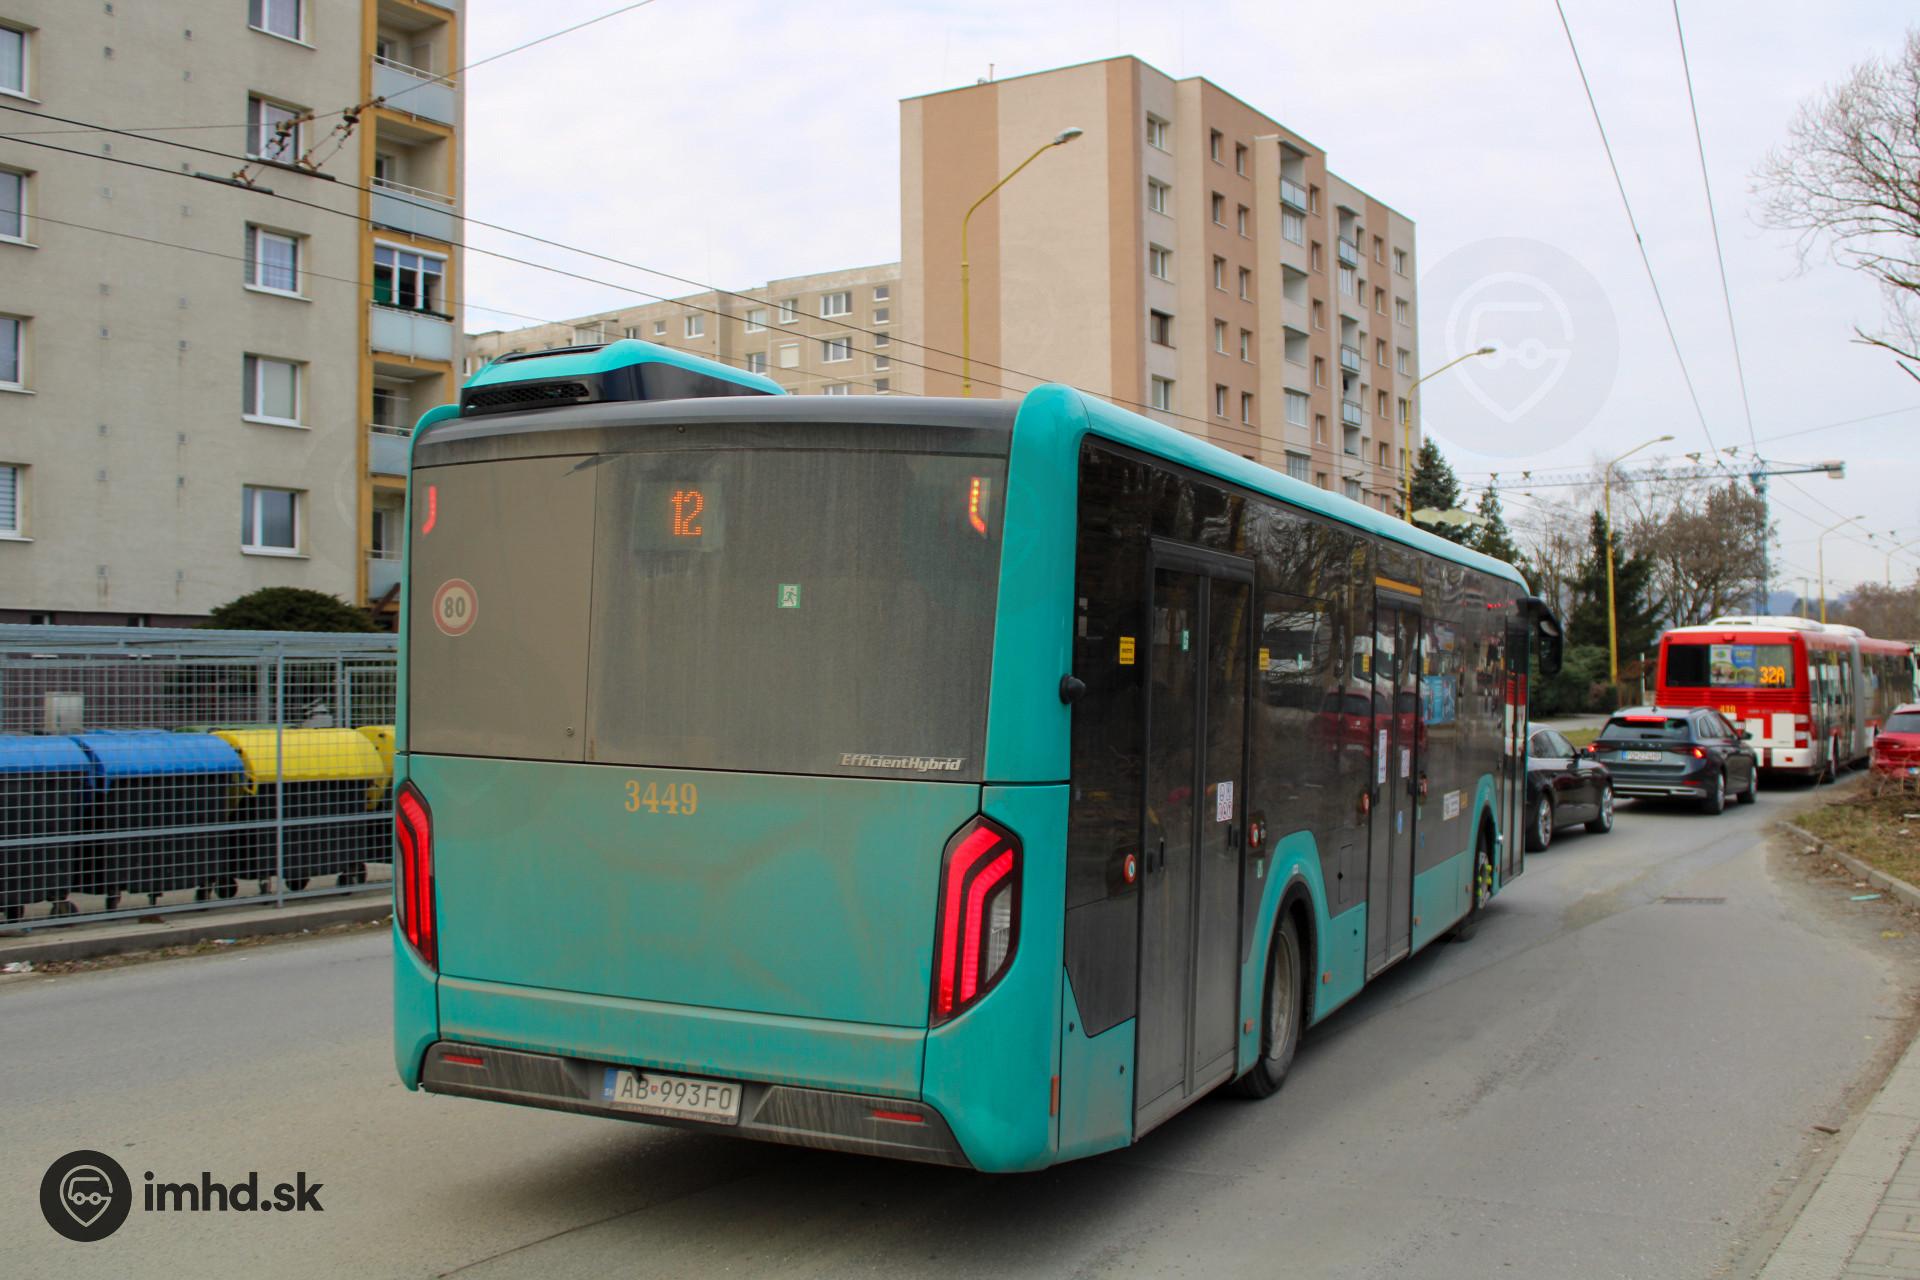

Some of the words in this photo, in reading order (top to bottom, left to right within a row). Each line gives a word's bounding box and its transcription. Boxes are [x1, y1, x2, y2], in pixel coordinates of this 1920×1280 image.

[671, 490, 705, 536] 12
[444, 596, 466, 618] 80
[1760, 666, 1785, 685] 32A
[841, 754, 962, 772] EfficientHybrid
[624, 779, 699, 816] 3449
